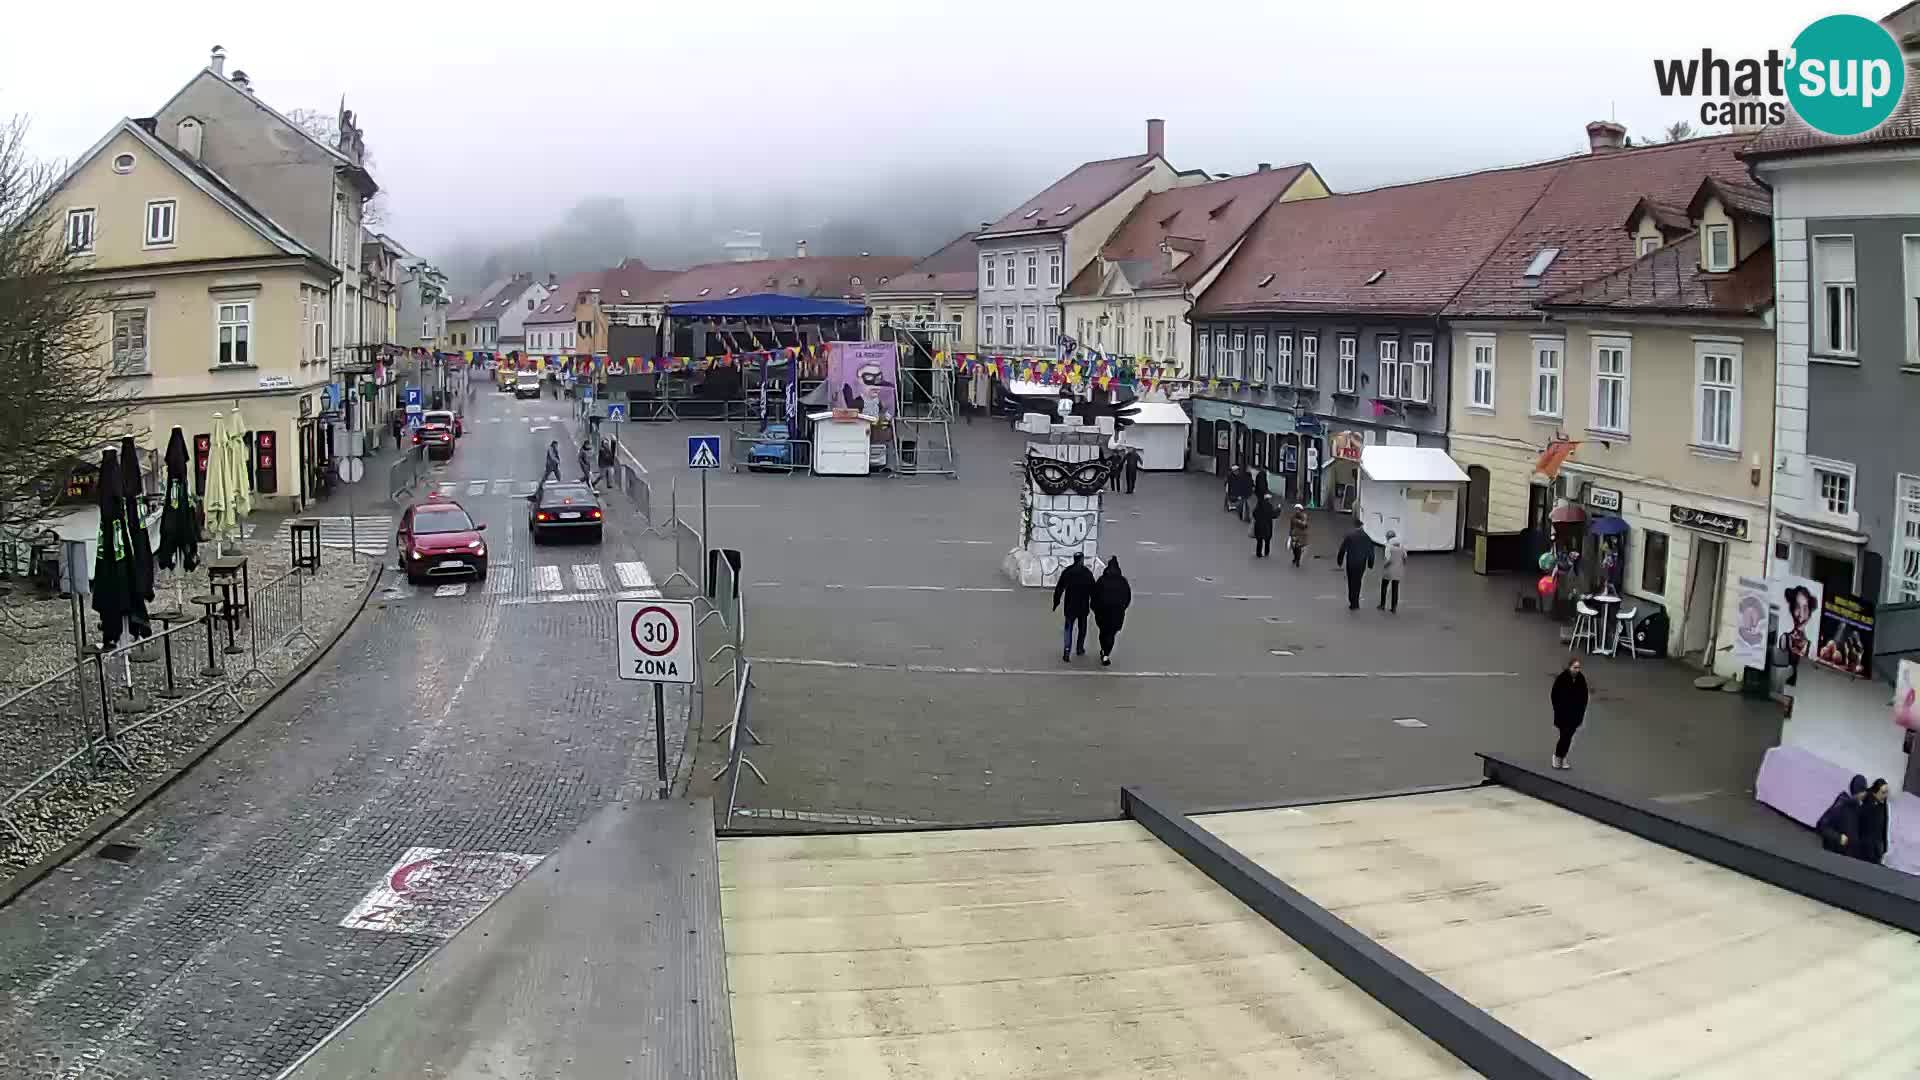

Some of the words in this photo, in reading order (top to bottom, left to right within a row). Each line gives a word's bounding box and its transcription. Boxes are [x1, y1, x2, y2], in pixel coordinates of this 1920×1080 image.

[410, 391, 417, 403] P
[643, 622, 668, 643] 30
[634, 659, 679, 677] ZONA
